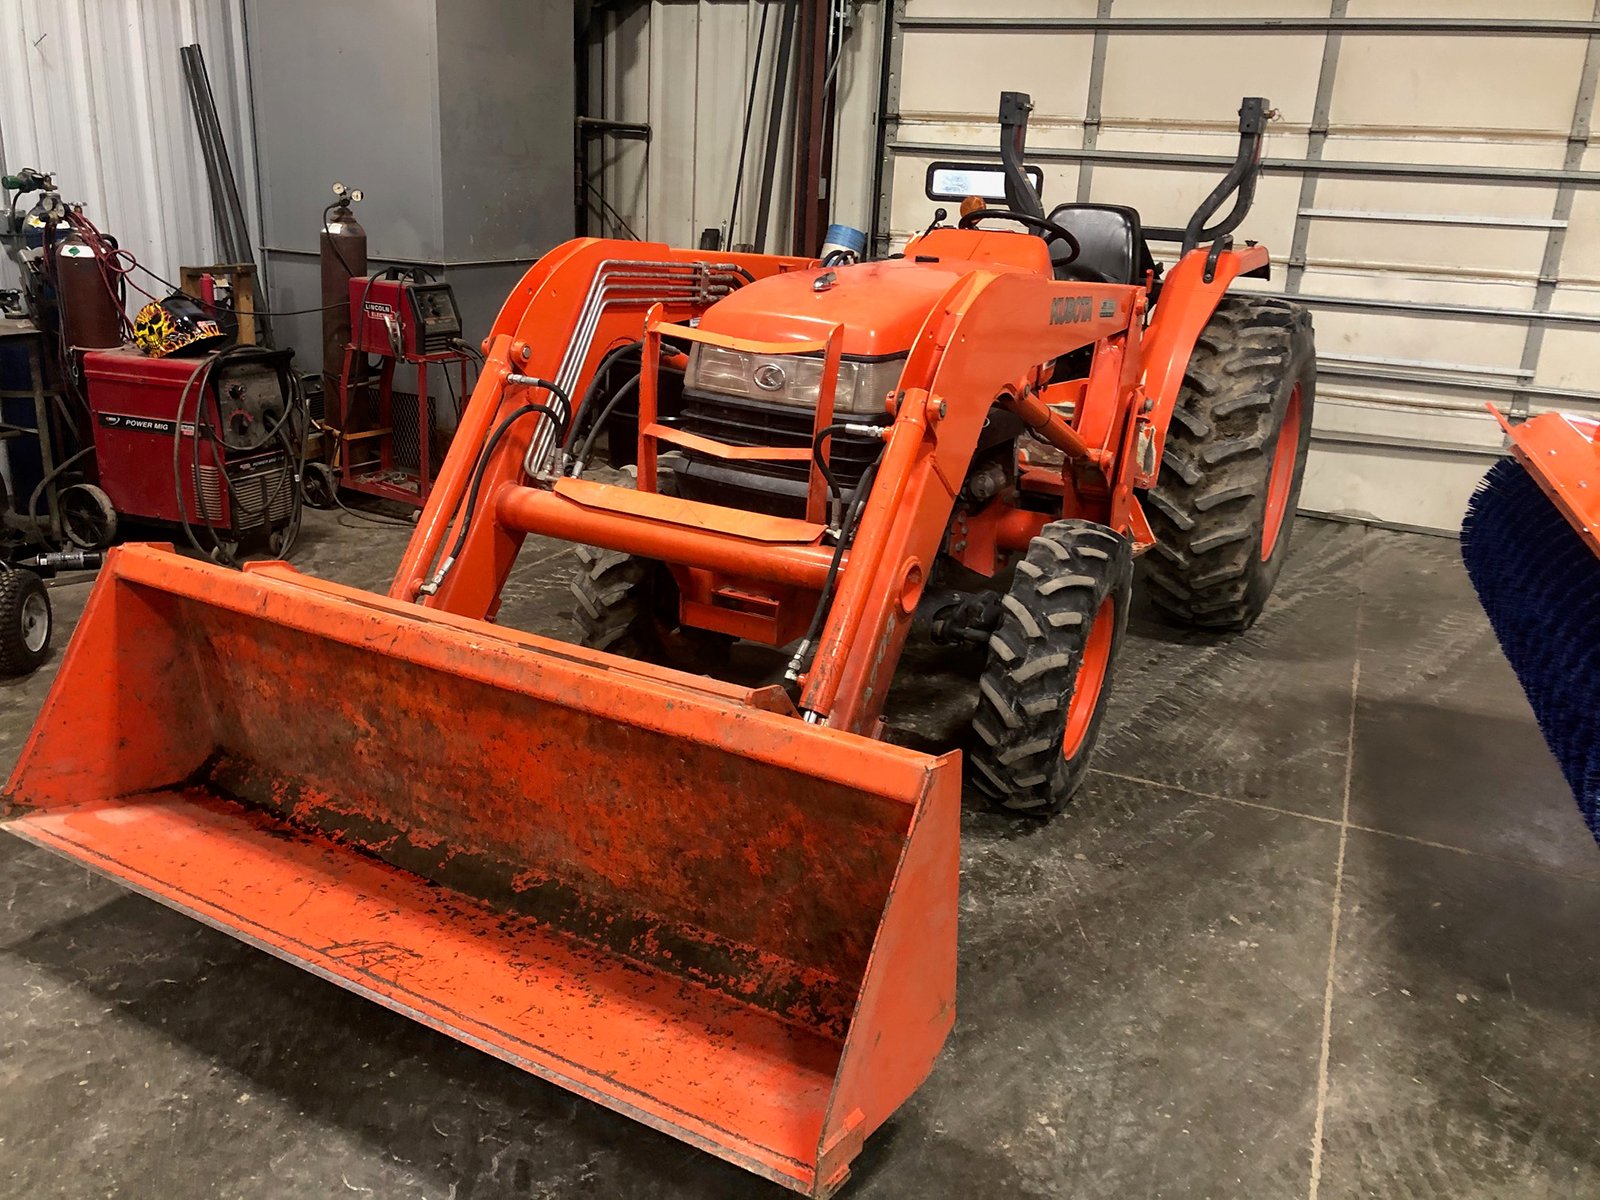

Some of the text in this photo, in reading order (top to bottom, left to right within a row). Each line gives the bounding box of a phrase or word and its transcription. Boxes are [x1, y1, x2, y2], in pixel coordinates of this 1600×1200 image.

[365, 303, 390, 312] LINCOLN
[1050, 296, 1093, 325] KUBOTA
[125, 419, 153, 429] POWER
[153, 423, 169, 431] MIG
